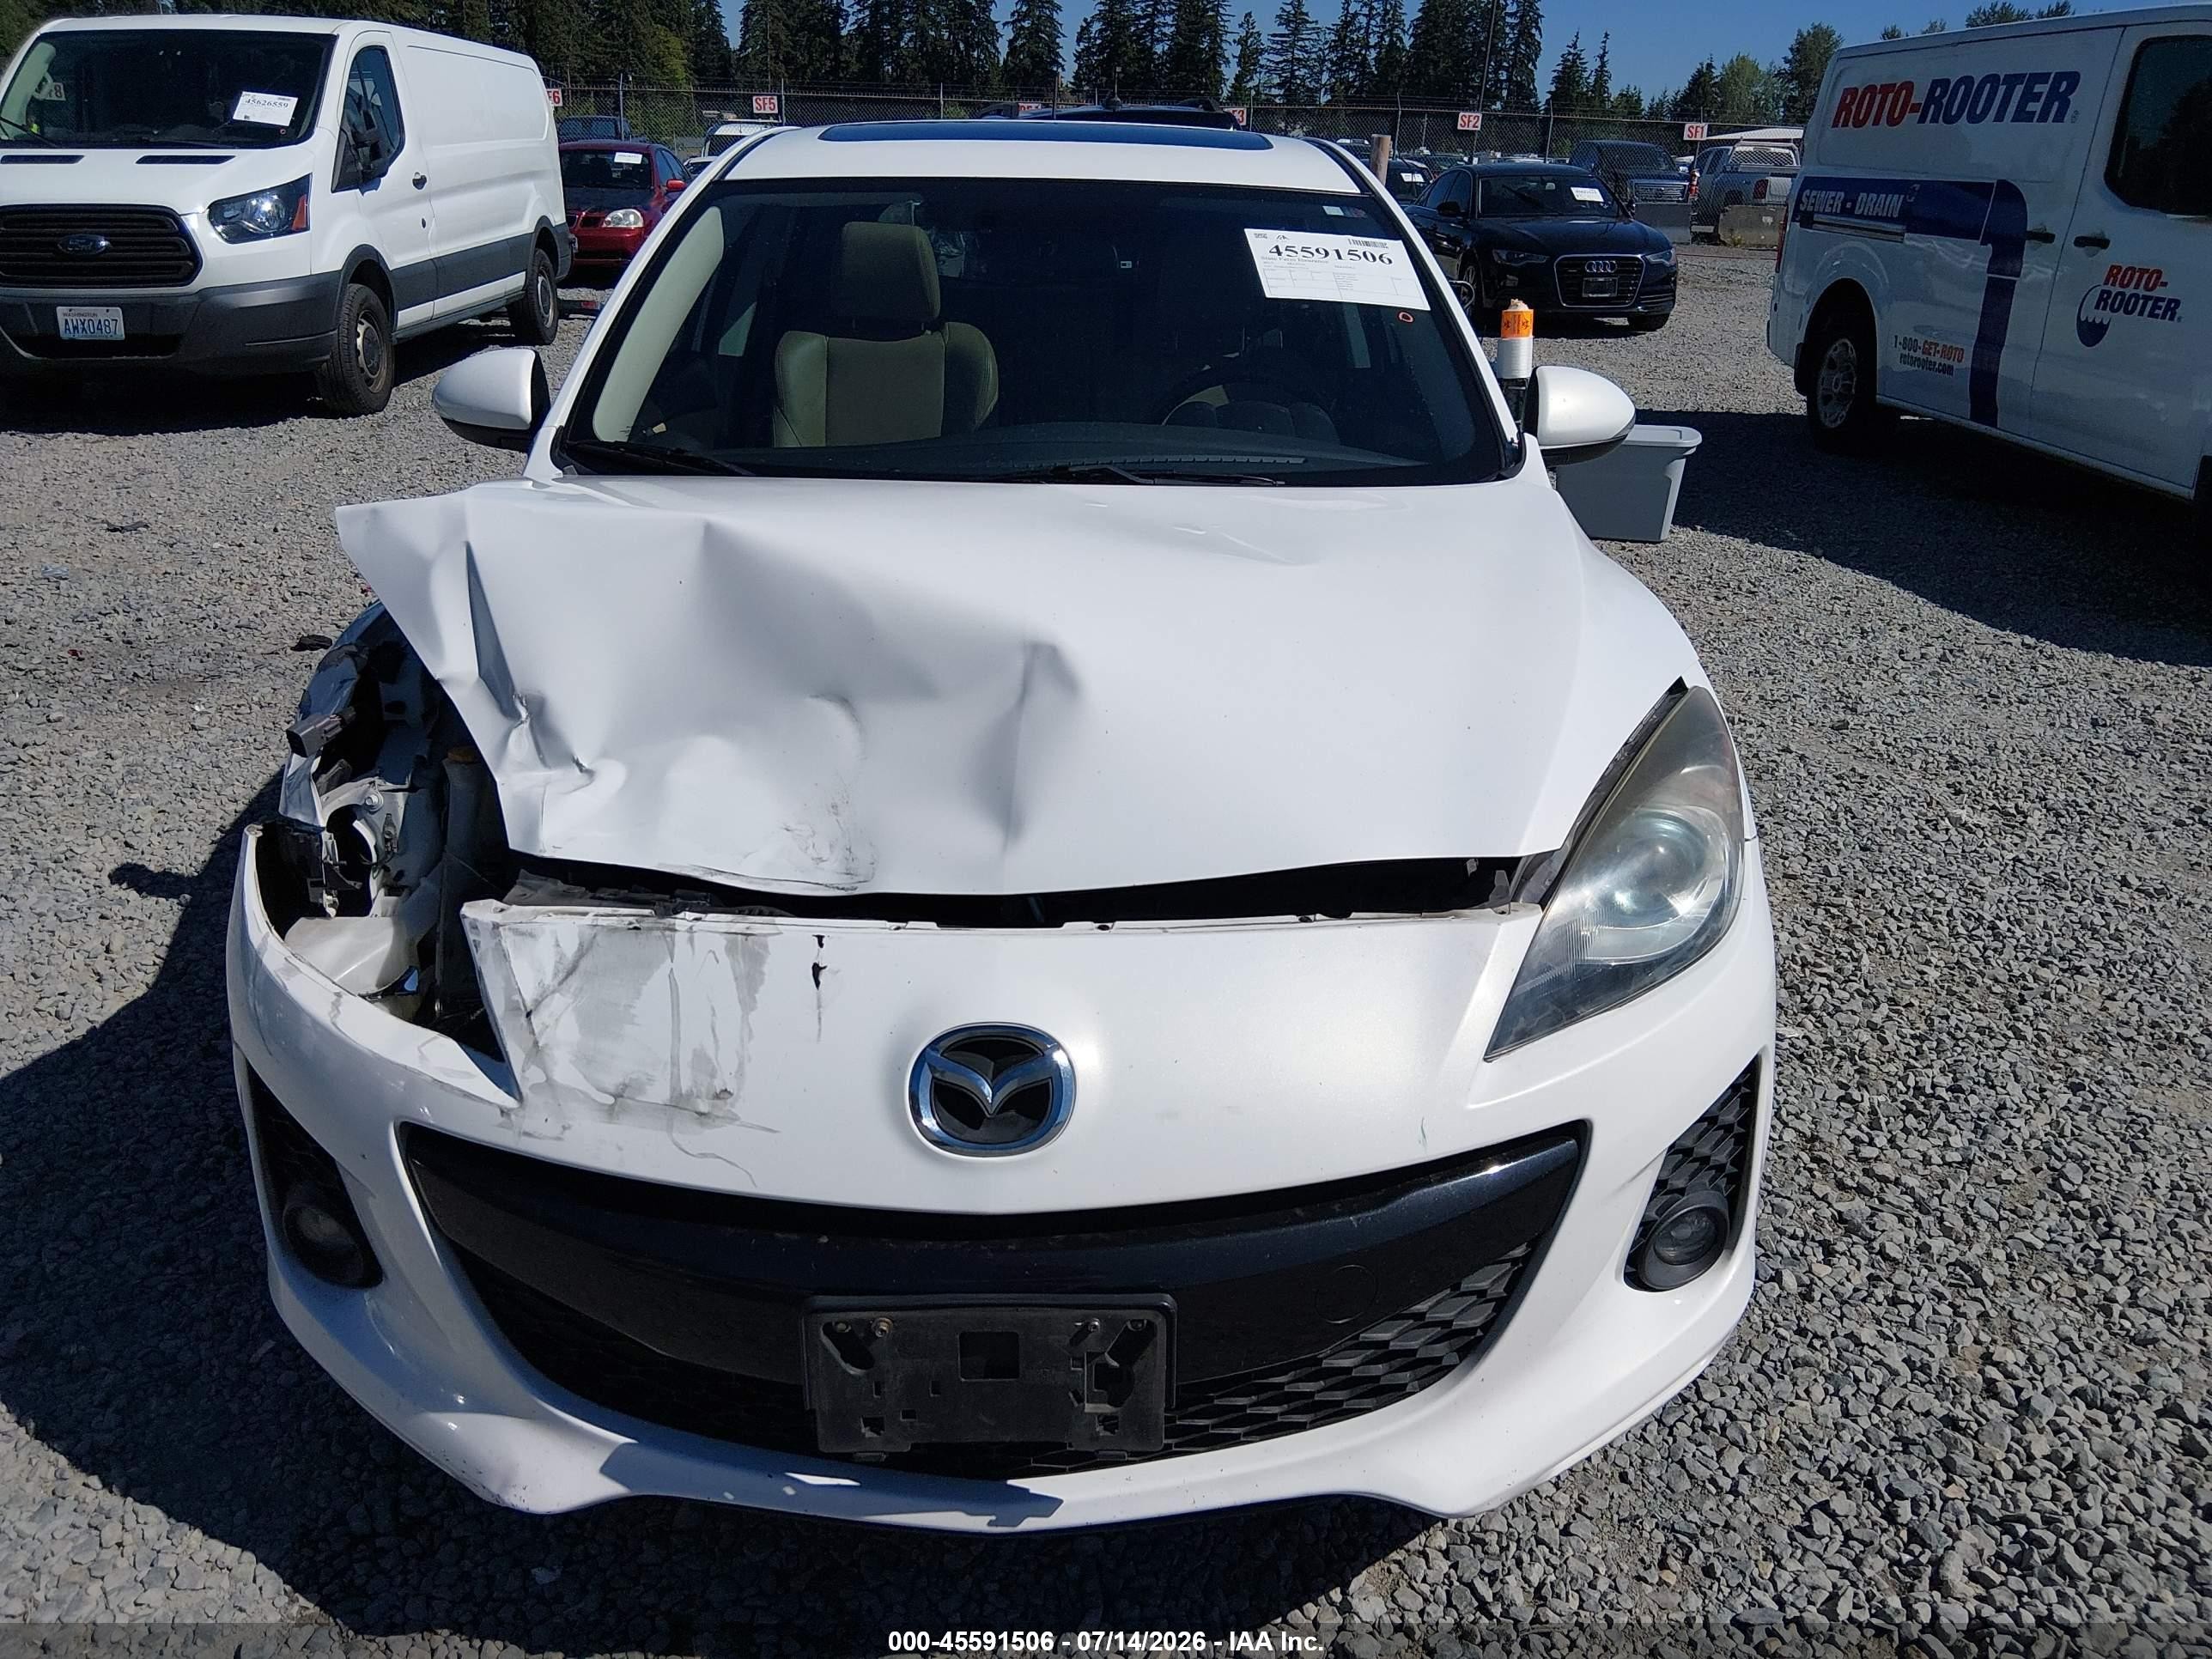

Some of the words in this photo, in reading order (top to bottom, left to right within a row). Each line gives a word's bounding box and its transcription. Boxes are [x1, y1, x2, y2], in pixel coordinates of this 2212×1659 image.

[246, 98, 289, 108] 45626559
[755, 97, 776, 112] SF5
[1832, 70, 2081, 128] ROTO-ROOTER
[1460, 114, 1480, 129] SF2
[1687, 125, 1705, 139] SF1
[1800, 189, 1844, 214] SEWER
[1855, 191, 1905, 218] DRAIN
[1268, 244, 1394, 266] 45591506
[2103, 264, 2168, 292] ROTO-
[2094, 289, 2181, 322] ROOTER
[64, 319, 118, 335] AWX0487
[1894, 335, 1965, 363] 1-800-GET-ROTO
[1899, 352, 1954, 376] rotorooter.com
